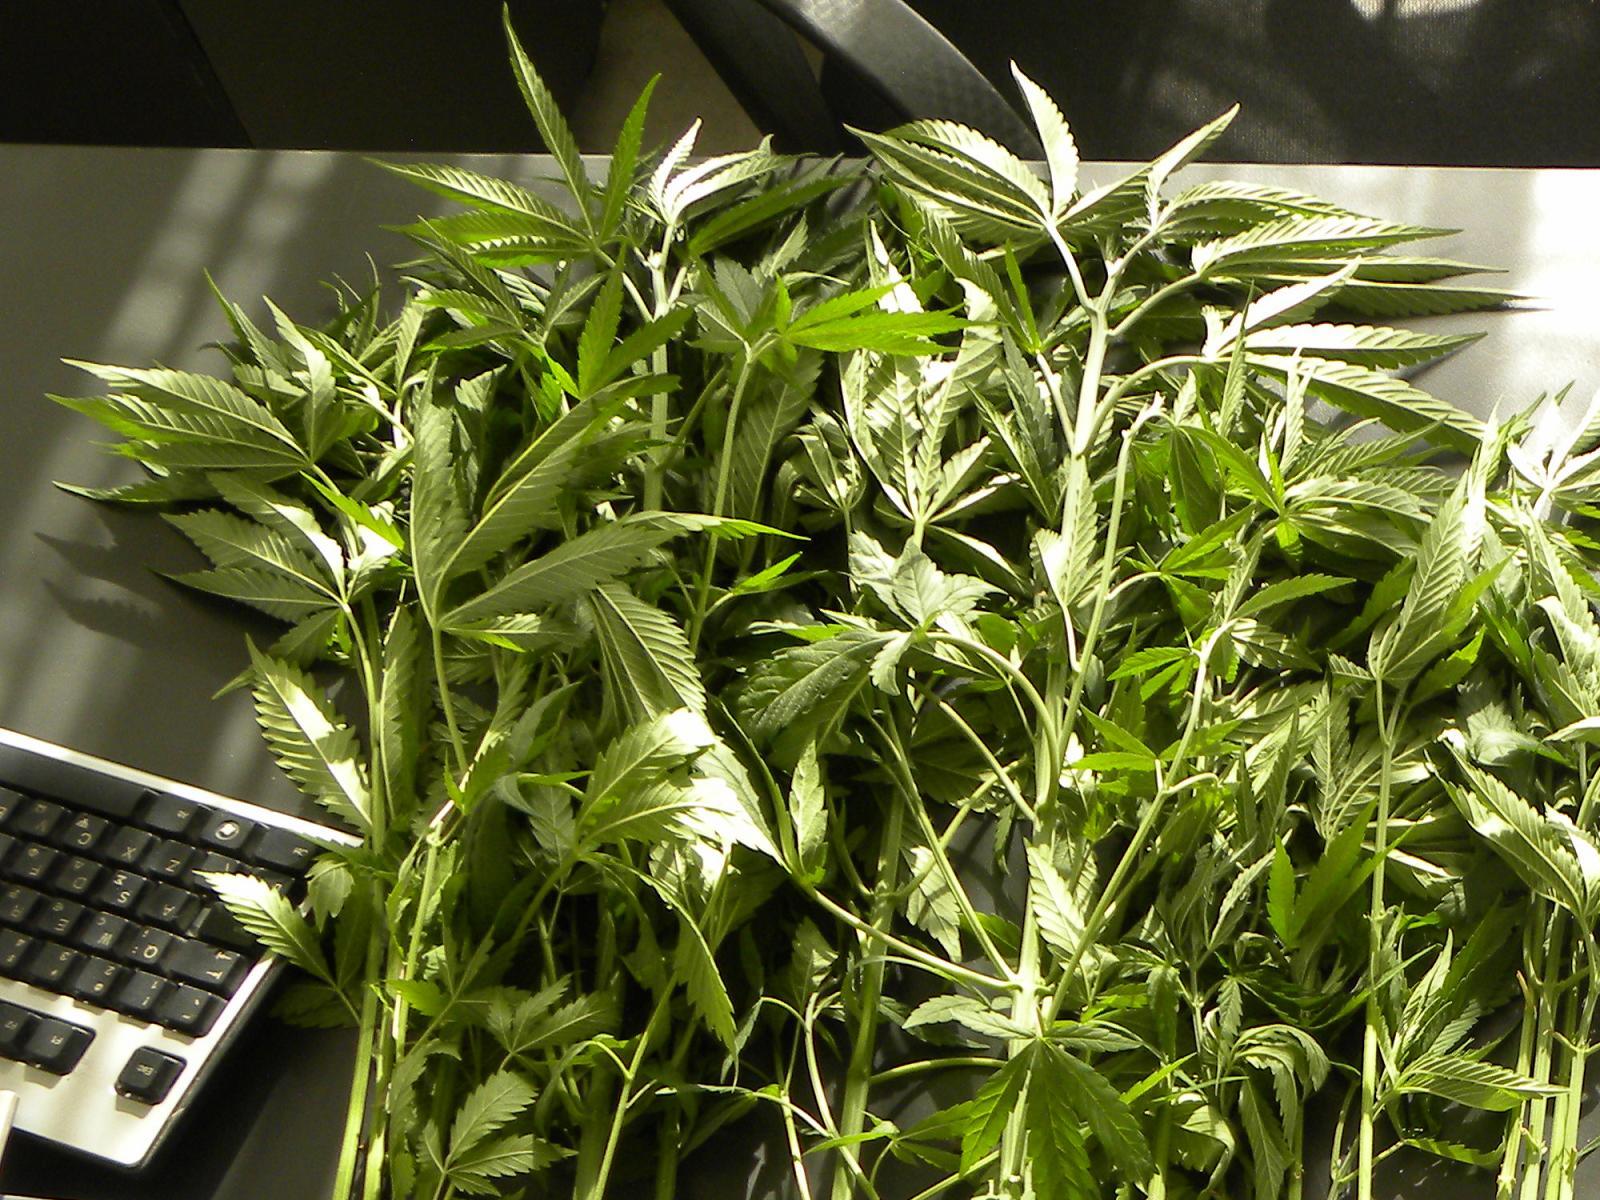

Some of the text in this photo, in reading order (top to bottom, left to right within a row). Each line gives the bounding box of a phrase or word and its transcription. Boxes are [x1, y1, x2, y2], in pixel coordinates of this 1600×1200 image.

[77, 832, 92, 845] C
[121, 846, 137, 860] X
[165, 859, 181, 872] Z
[117, 891, 131, 903] S
[163, 904, 176, 916] A
[54, 918, 69, 931] E
[144, 944, 158, 958] Q
